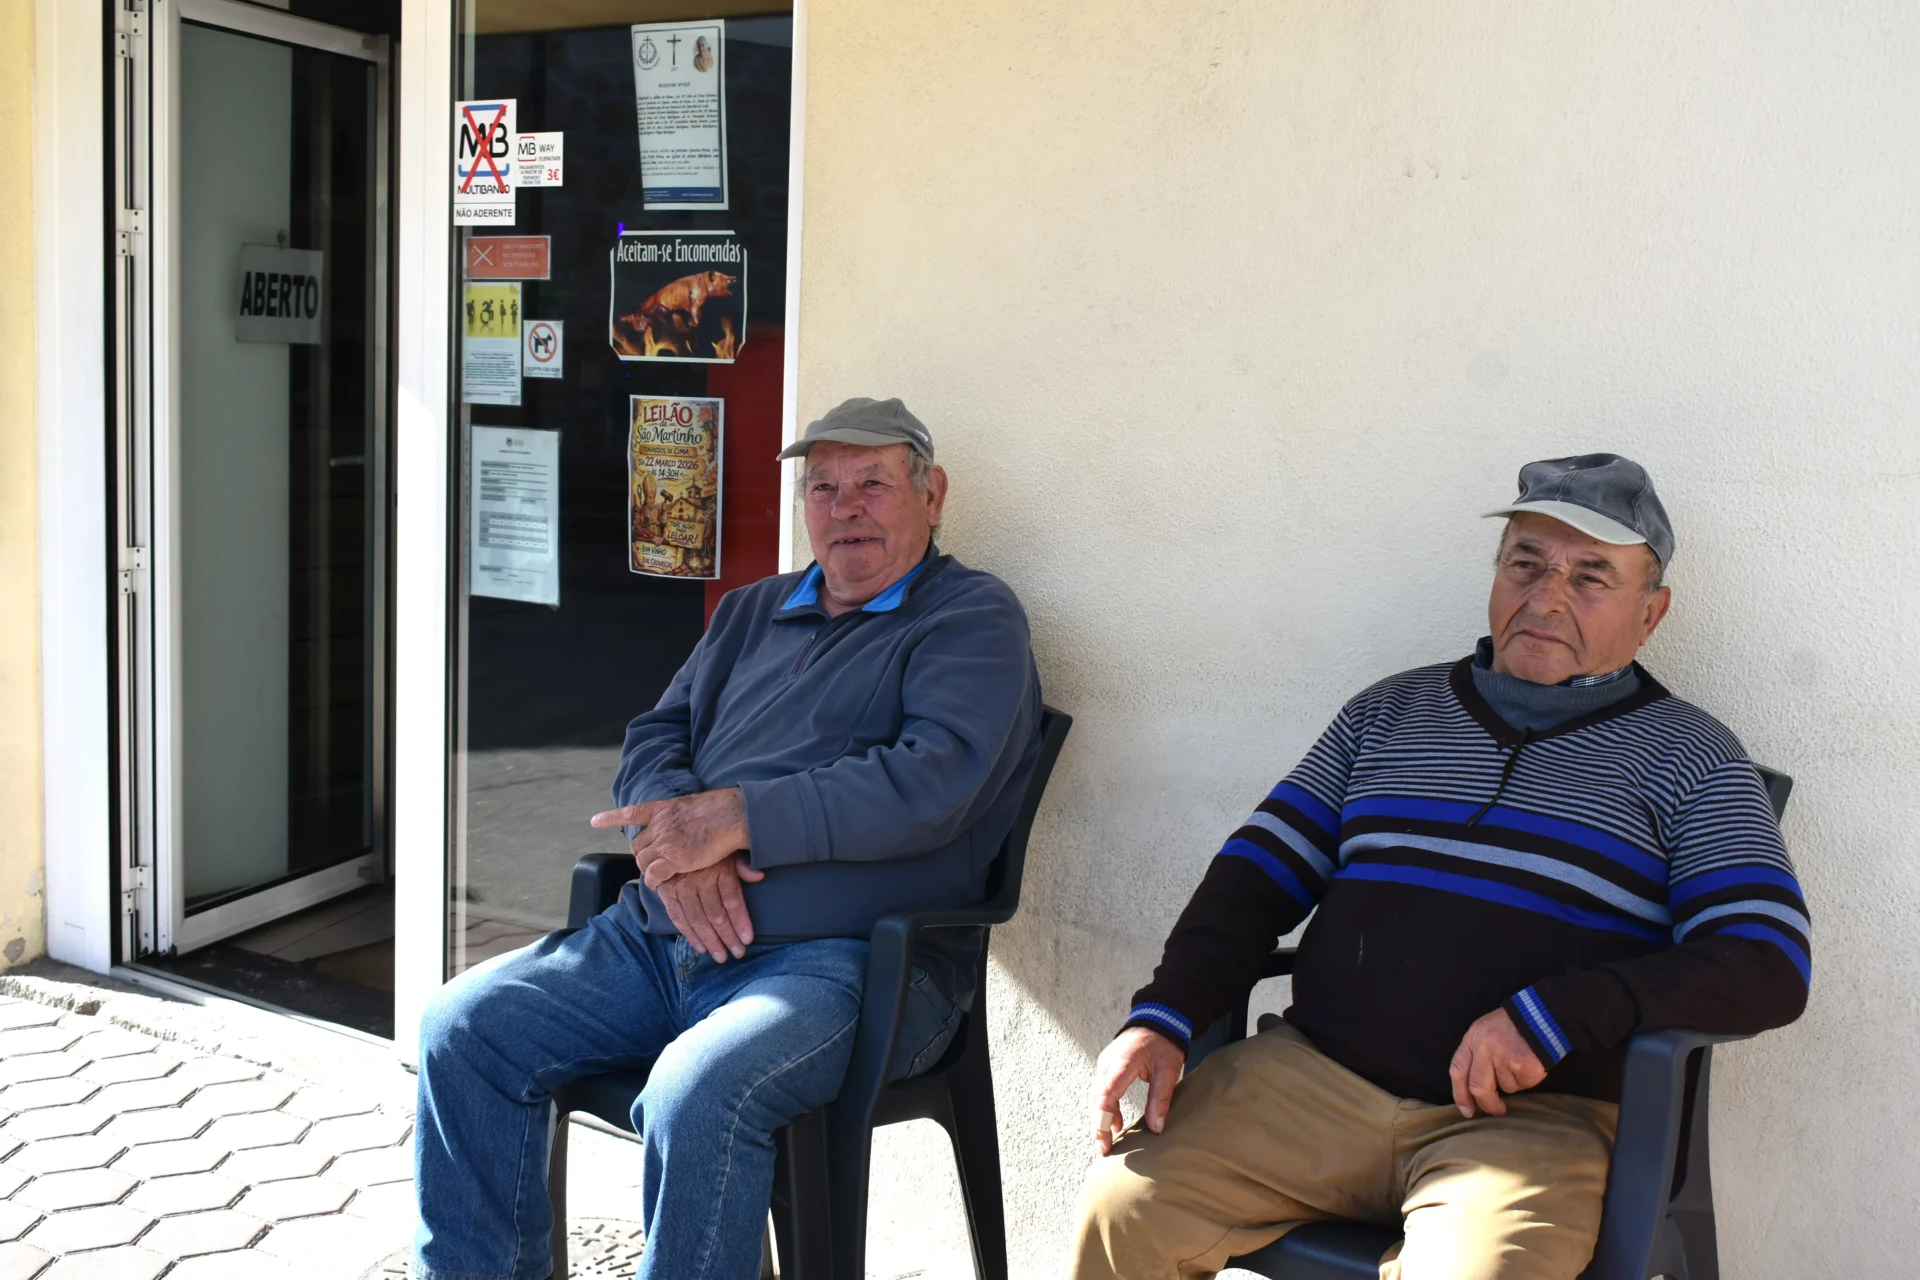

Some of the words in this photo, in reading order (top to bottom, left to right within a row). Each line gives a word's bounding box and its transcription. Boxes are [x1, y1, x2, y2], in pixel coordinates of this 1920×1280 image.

[459, 123, 509, 159] MB
[518, 142, 536, 155] MB
[539, 143, 555, 153] WAY
[547, 168, 560, 181] 3€
[456, 207, 472, 218] NÃO
[473, 208, 513, 218] ADERENTE
[617, 239, 672, 262] Aceitam-se
[675, 239, 740, 262] Encomendas
[239, 271, 319, 320] ABERTO
[636, 425, 652, 444] São
[651, 426, 703, 446] Martinho
[645, 456, 654, 467] 22
[655, 458, 676, 468] MARÇO
[677, 459, 699, 470] 2026
[651, 546, 667, 556] VINHO
